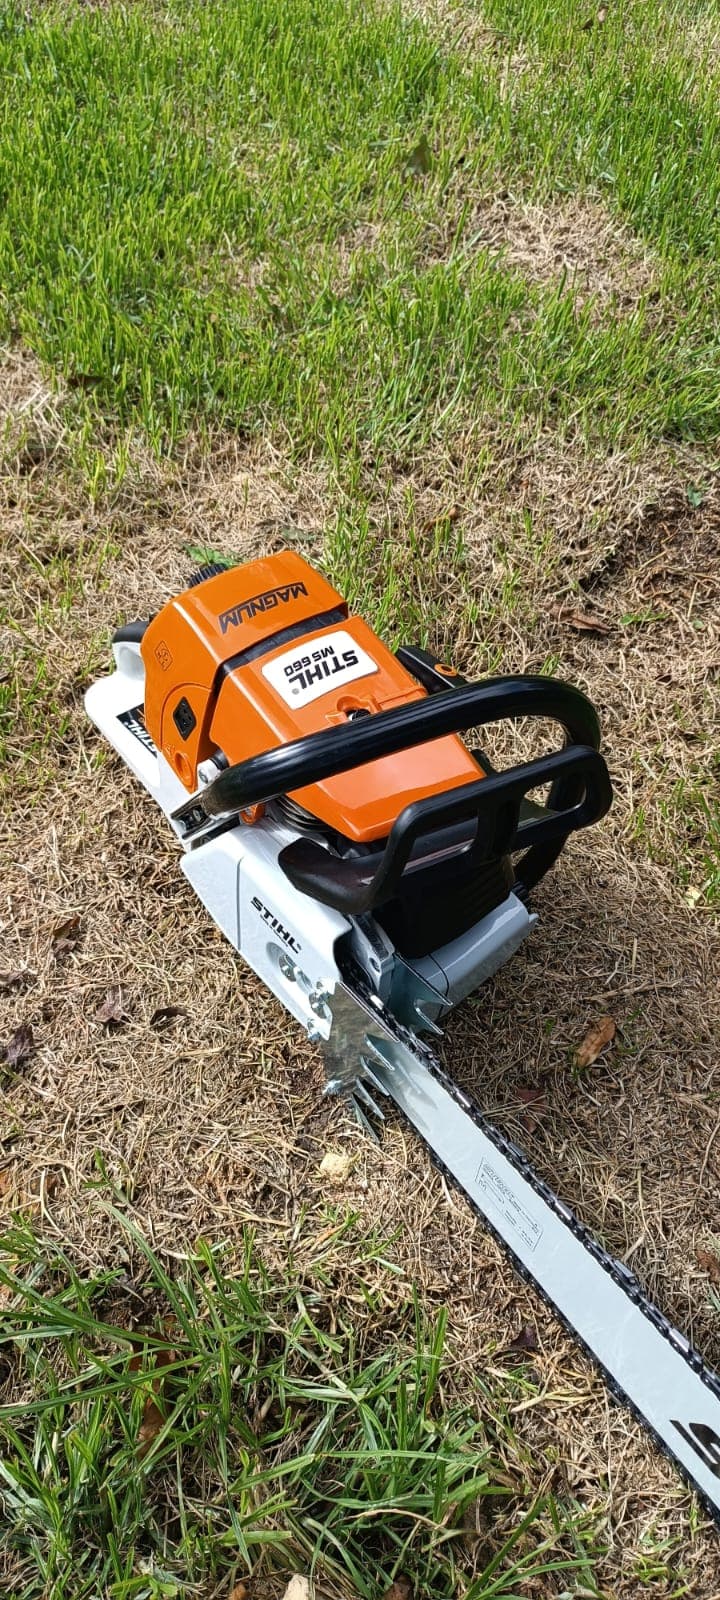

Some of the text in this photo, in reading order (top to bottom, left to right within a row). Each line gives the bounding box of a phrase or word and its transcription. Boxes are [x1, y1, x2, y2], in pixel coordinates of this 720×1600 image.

[218, 582, 309, 634] MAGNUM
[284, 645, 335, 677] MS 660
[288, 649, 359, 690] STIHL
[250, 896, 300, 954] STIHL
